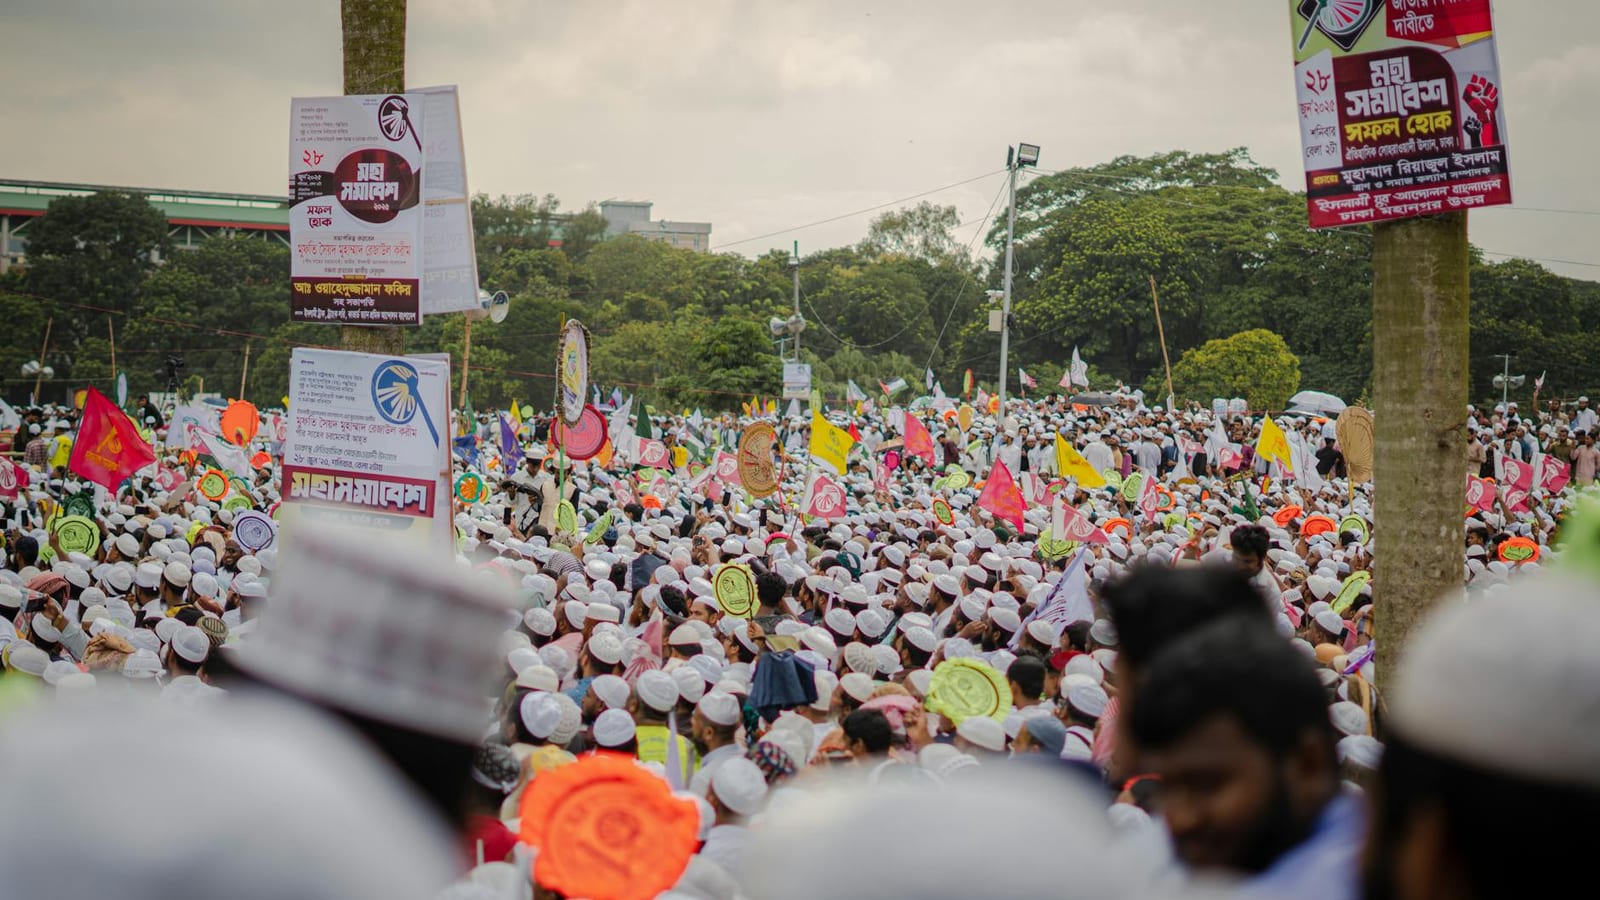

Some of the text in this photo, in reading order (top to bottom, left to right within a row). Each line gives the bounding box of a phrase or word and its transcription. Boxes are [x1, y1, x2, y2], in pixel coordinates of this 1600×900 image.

[1392, 10, 1434, 36] দাবীতে
[1305, 69, 1331, 95] ২৮
[1369, 56, 1411, 87] মহা
[1344, 78, 1449, 117] সমাবেশ
[1344, 111, 1453, 142] সফল হোক
[303, 149, 324, 168] ২৮
[1341, 150, 1500, 184] মুহাম্মাদ রিয়াজুল ইসলাম
[357, 162, 385, 181] মহা
[1375, 181, 1383, 189] ও
[1385, 177, 1413, 187] সমাজ
[1449, 167, 1490, 178] সম্পাদক
[341, 181, 400, 201] সমাবেশ
[1315, 179, 1502, 212] ইসলামী যুব আন্দোলন বাংলাদেশ
[307, 205, 333, 215] সফল
[373, 202, 390, 211] ২০২৫
[1339, 194, 1485, 220] ঢাকা মহানগর উত্তর
[309, 217, 333, 228] হোক
[294, 281, 311, 294] আঃ
[384, 280, 412, 296] ফকির
[333, 296, 376, 307] সহ সভাপতি
[296, 415, 317, 428] মুফতি
[319, 417, 338, 428] সৈয়দ
[294, 453, 304, 463] ২৮
[290, 471, 427, 513] মহাসমাবেশ
